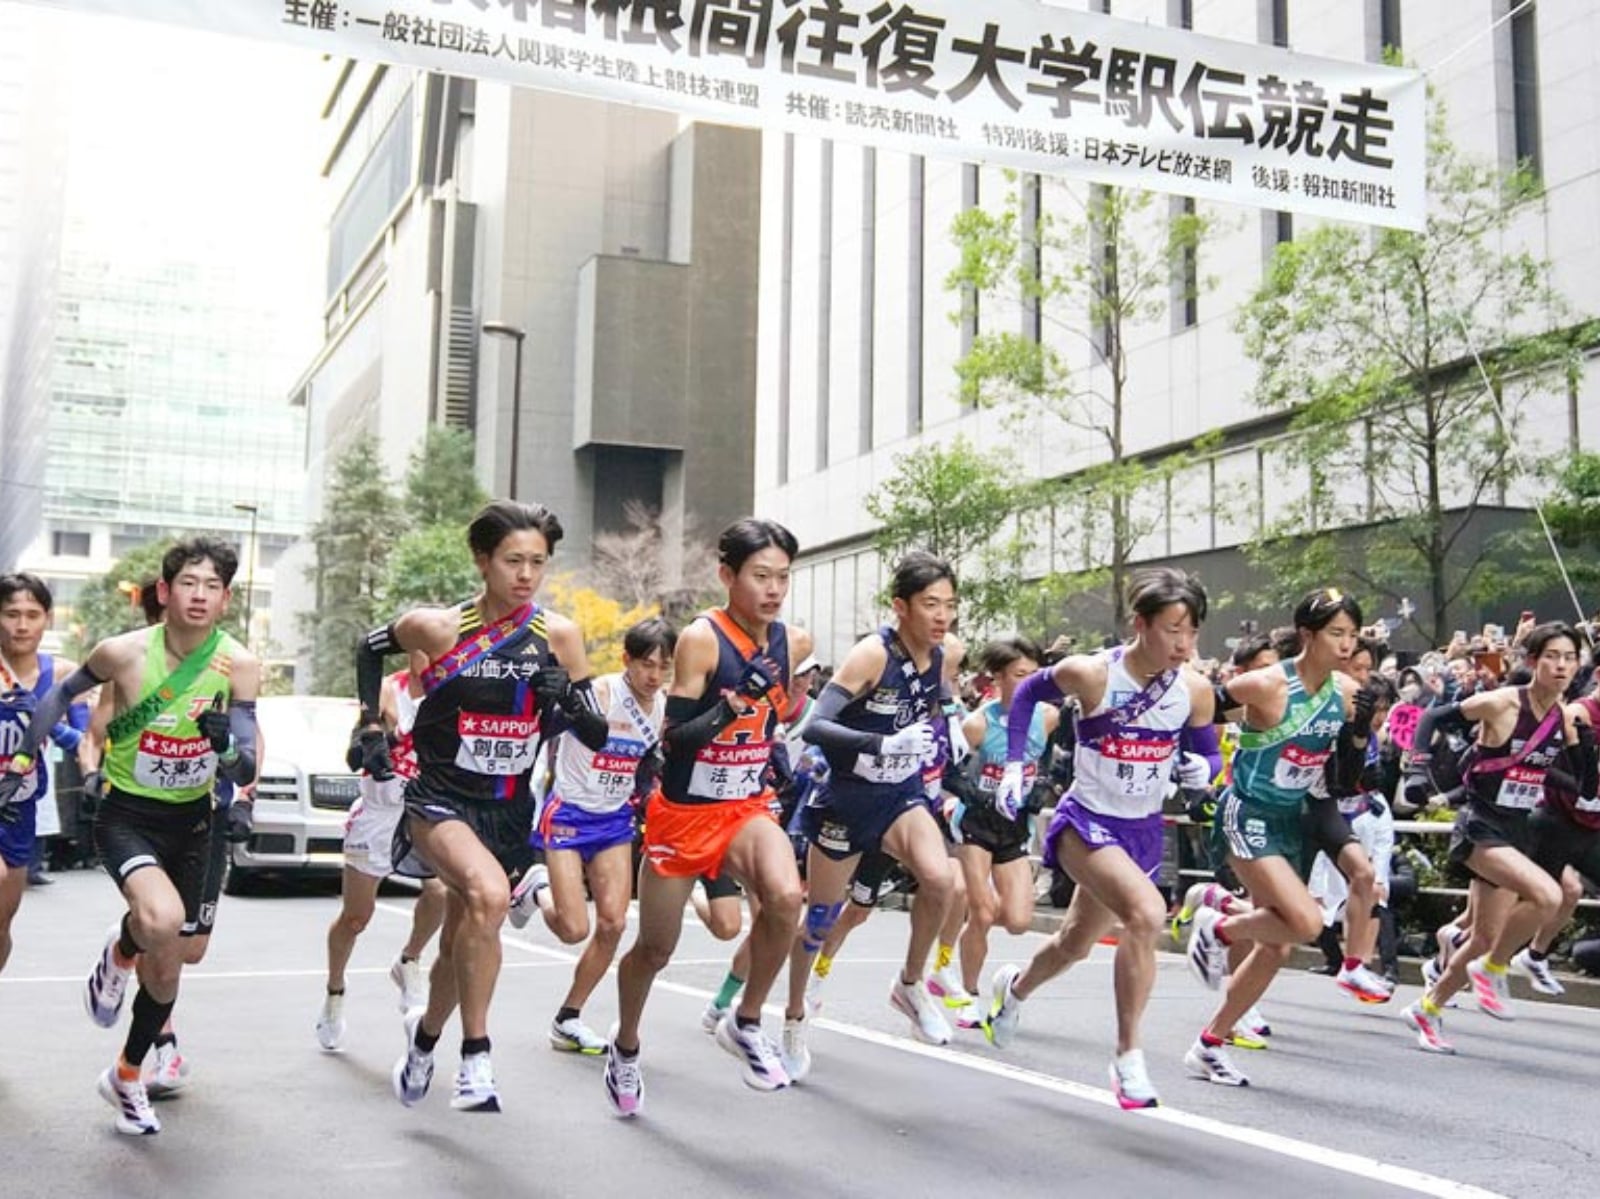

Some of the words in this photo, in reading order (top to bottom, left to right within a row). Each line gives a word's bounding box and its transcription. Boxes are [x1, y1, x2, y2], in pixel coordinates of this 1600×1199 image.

[981, 122, 1232, 184] 特別後援：日本テレビ放送網
[1251, 165, 1396, 209] 後援：報知新聞社
